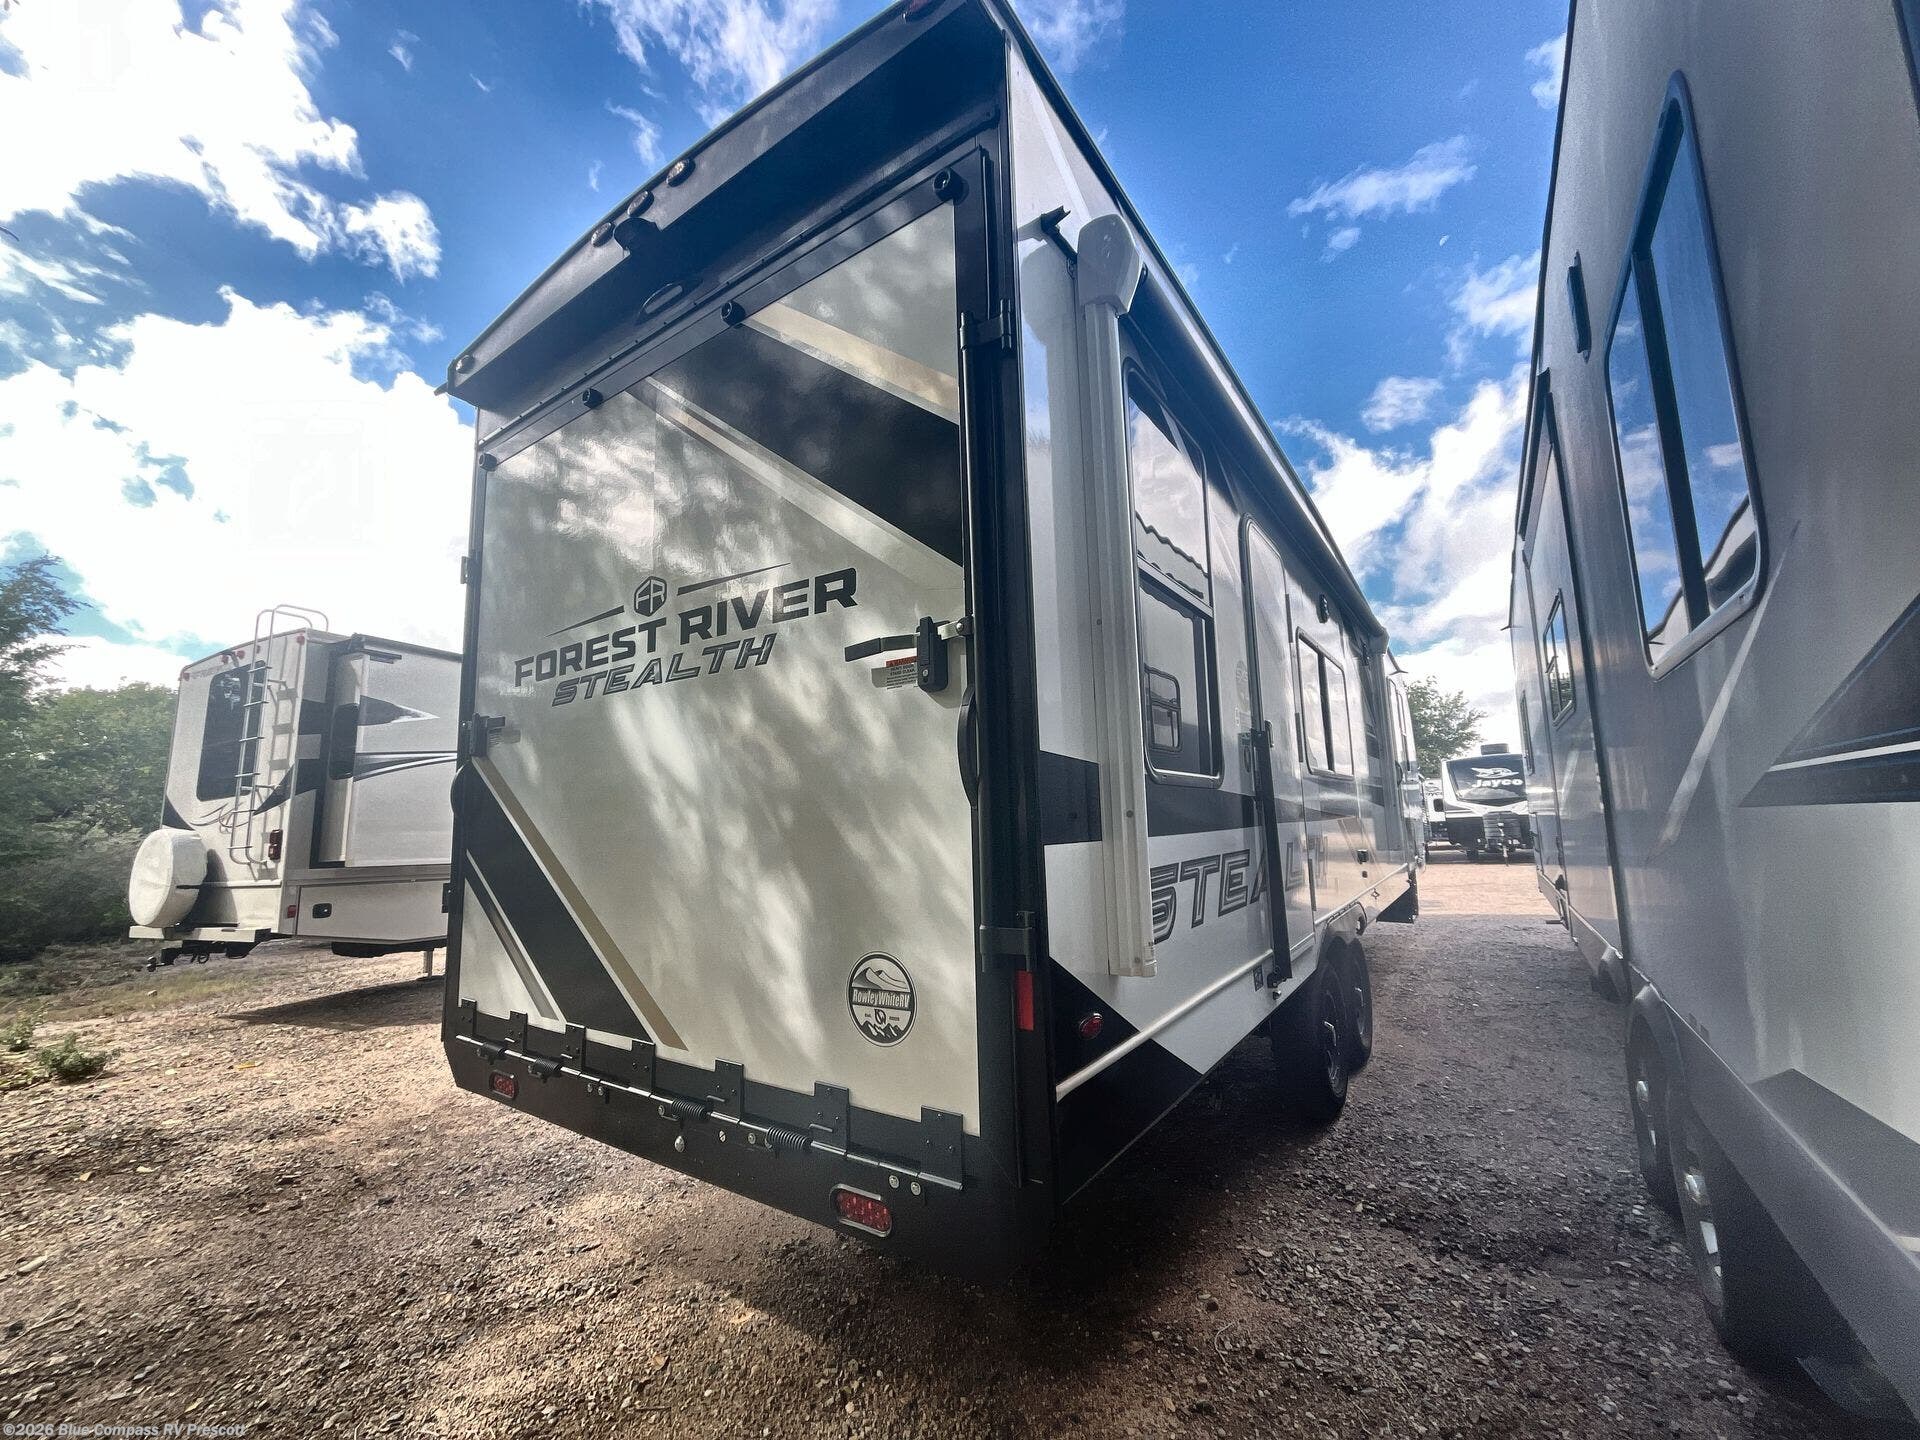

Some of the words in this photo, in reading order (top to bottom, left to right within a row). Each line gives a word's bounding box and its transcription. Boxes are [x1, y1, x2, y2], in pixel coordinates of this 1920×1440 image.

[514, 617, 667, 687] FOREST
[678, 567, 858, 645] RIVER
[551, 632, 777, 707] STEALTH
[1471, 778, 1524, 788] Jayco
